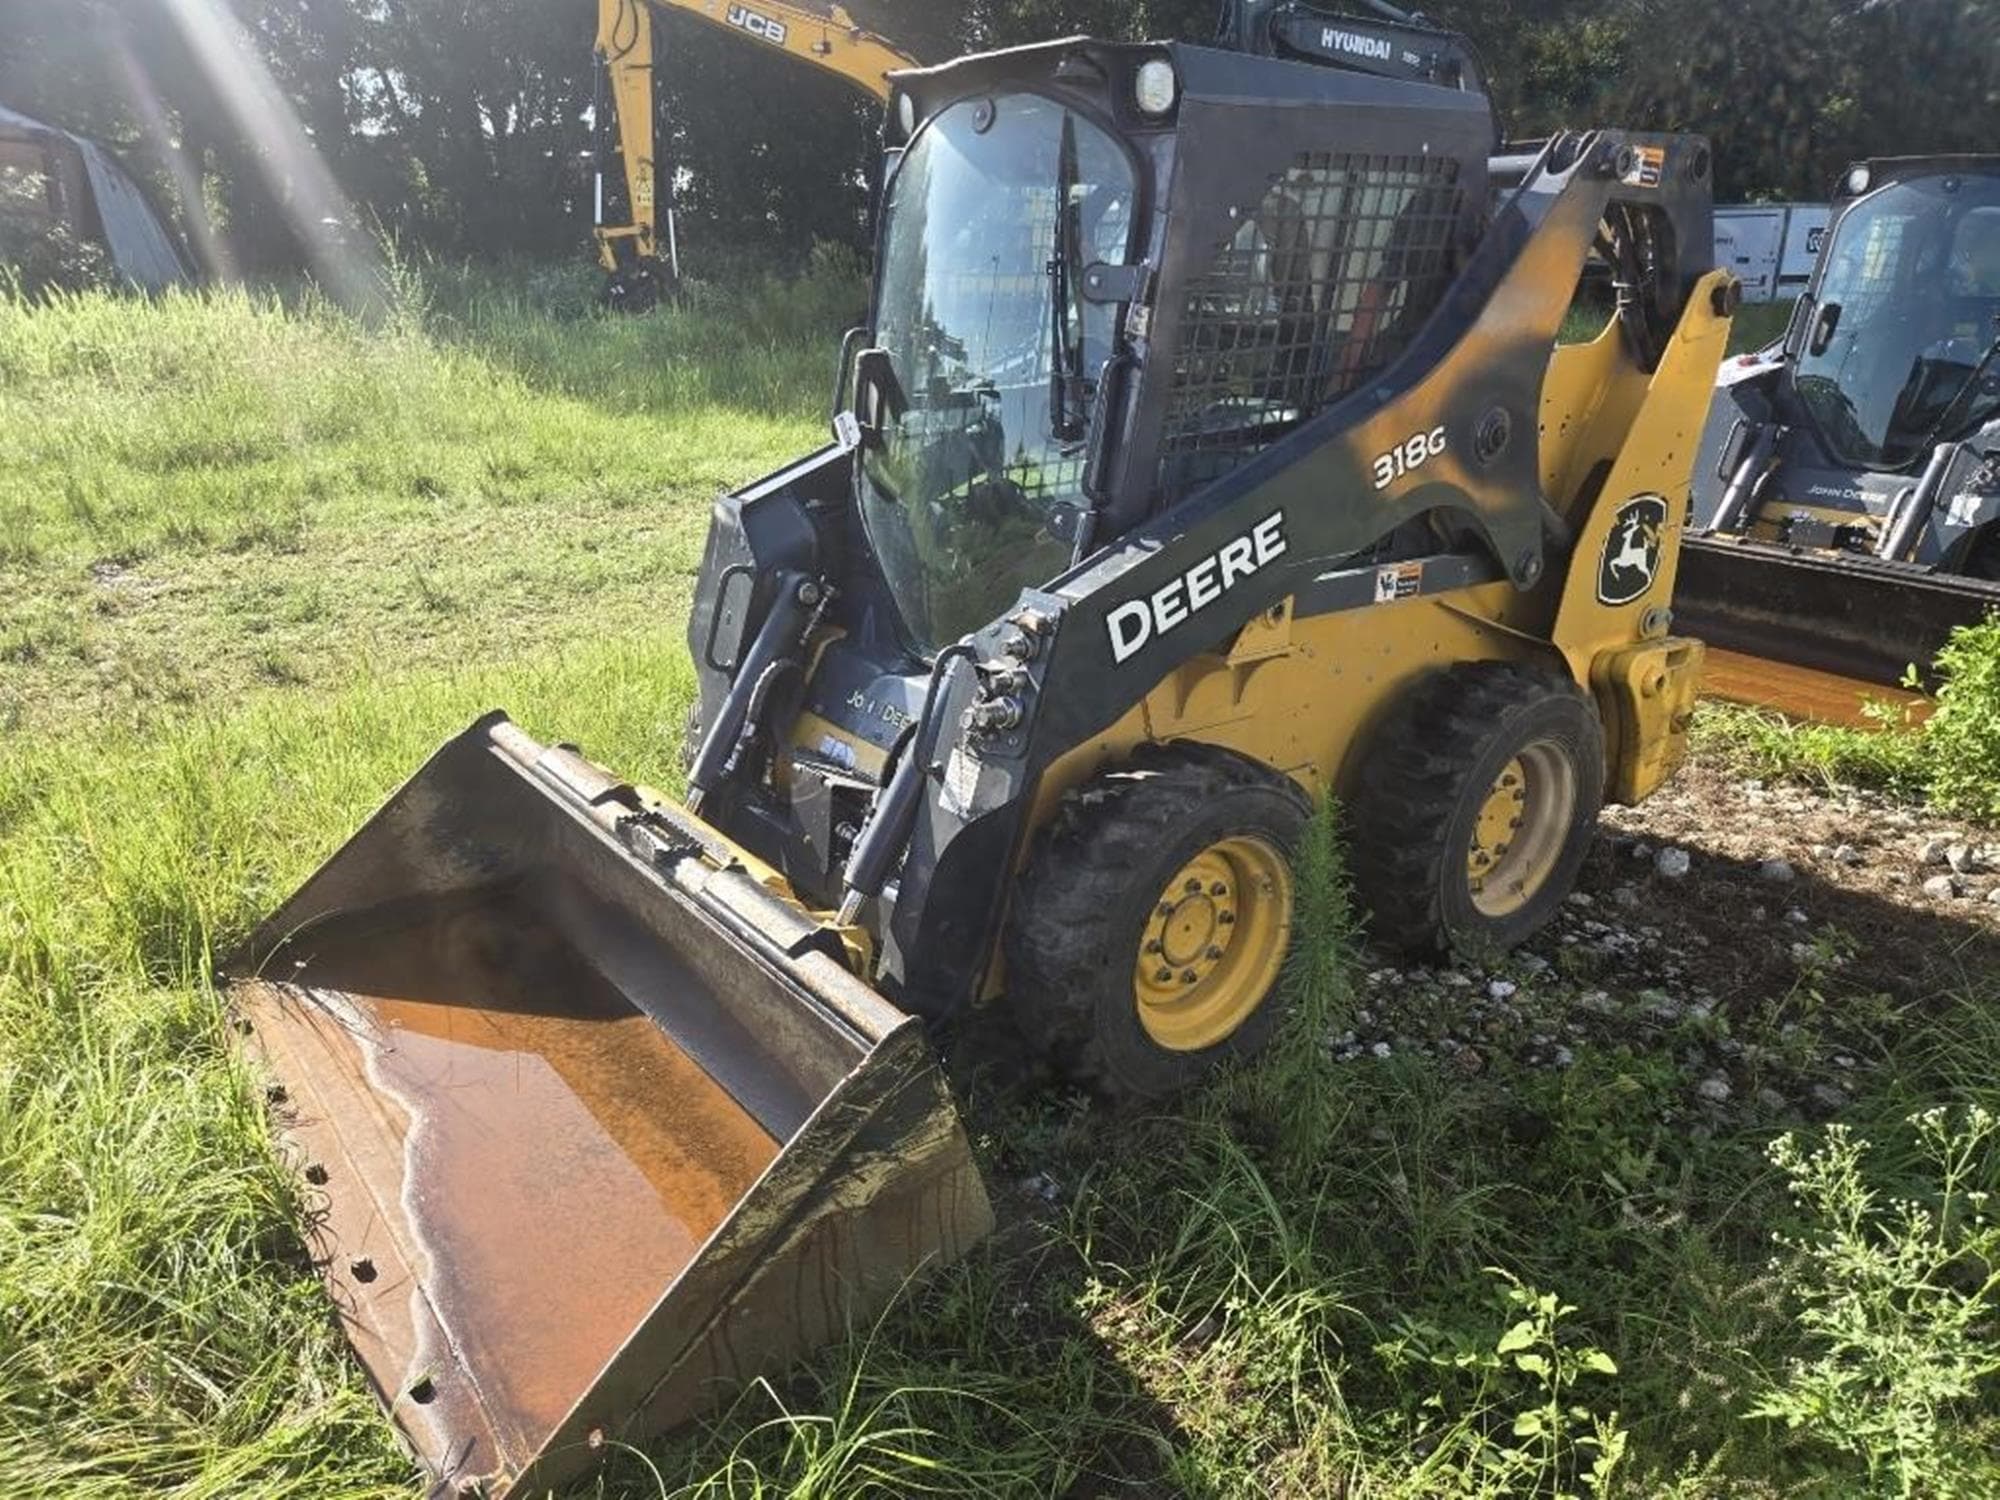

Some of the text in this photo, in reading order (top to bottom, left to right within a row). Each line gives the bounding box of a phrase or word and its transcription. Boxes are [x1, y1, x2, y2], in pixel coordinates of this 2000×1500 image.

[728, 5, 785, 42] JCB
[1321, 27, 1391, 60] HYUNDAI
[1373, 426, 1446, 489] 318G
[1105, 511, 1288, 665] DEERE
